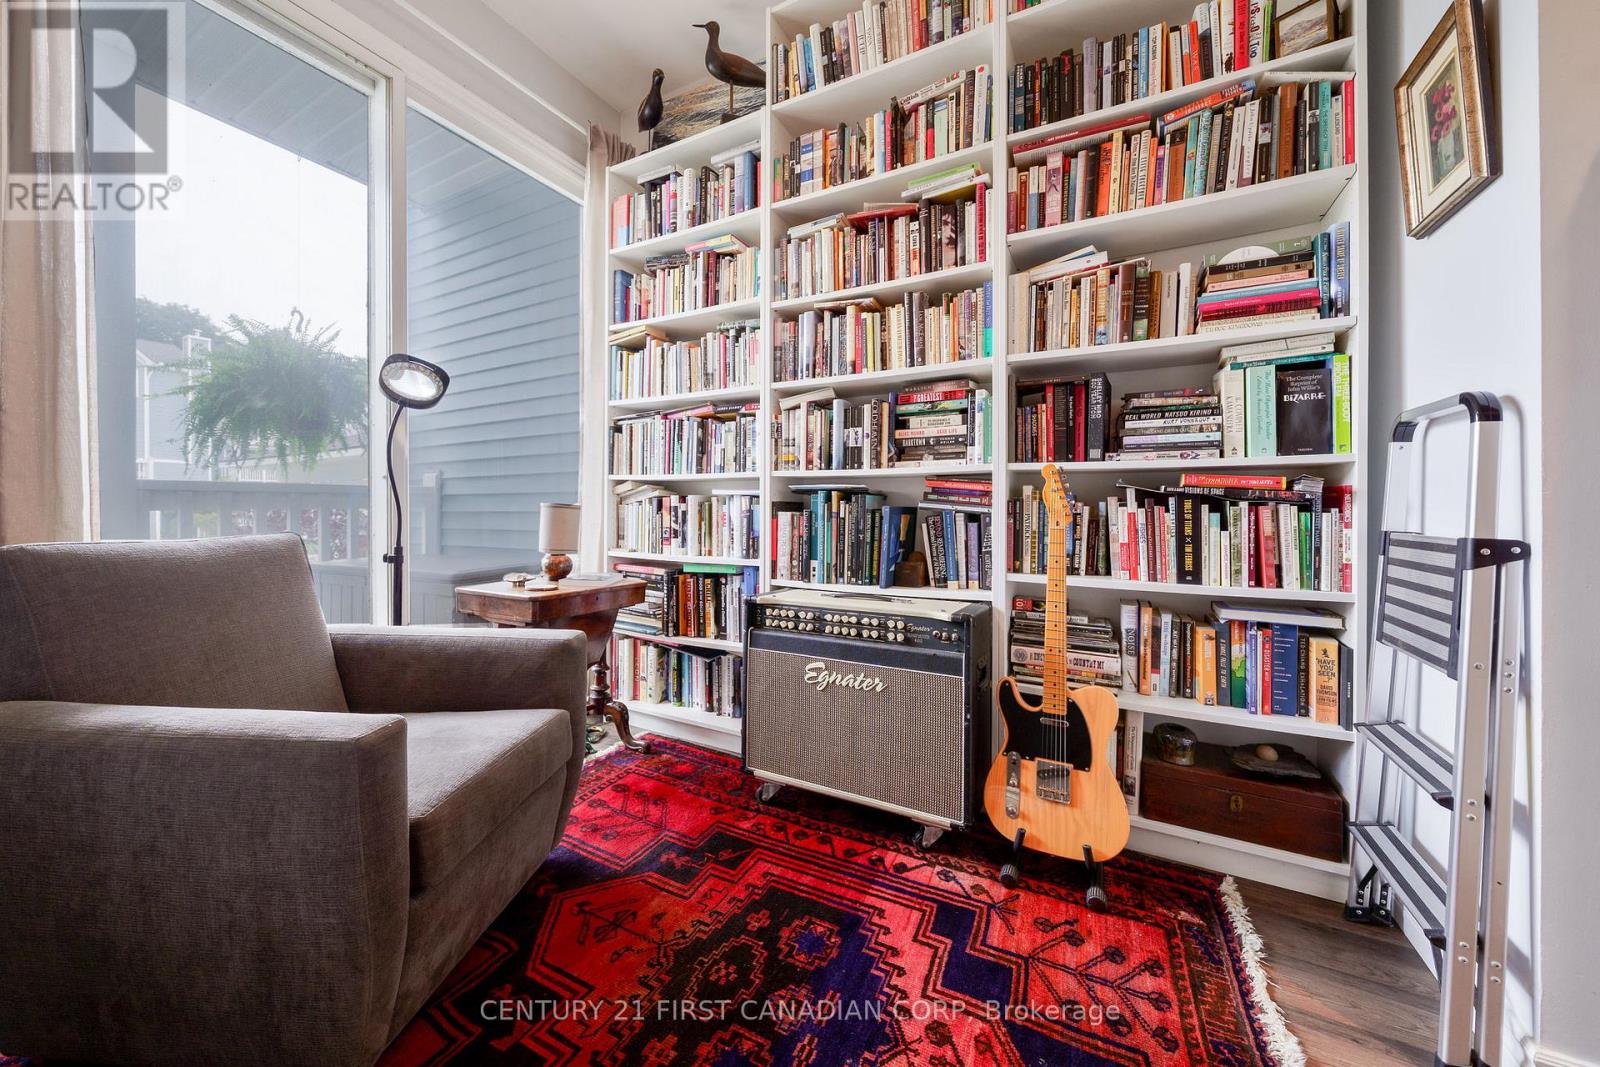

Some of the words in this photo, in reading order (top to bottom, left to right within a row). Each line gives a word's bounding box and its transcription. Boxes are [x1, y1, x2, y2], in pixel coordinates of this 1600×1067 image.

[1283, 392, 1327, 403] BIZARRE
[1140, 412, 1162, 420] WORLD
[1164, 410, 1188, 418] NATSUO
[1189, 409, 1212, 417] KIRINO
[1184, 499, 1193, 513] TOOLS
[1184, 520, 1193, 536] TITANS
[937, 538, 947, 578] REMEMBERING
[1126, 629, 1136, 656] NOISE
[1319, 664, 1334, 672] YOU
[804, 661, 888, 693] Egnater
